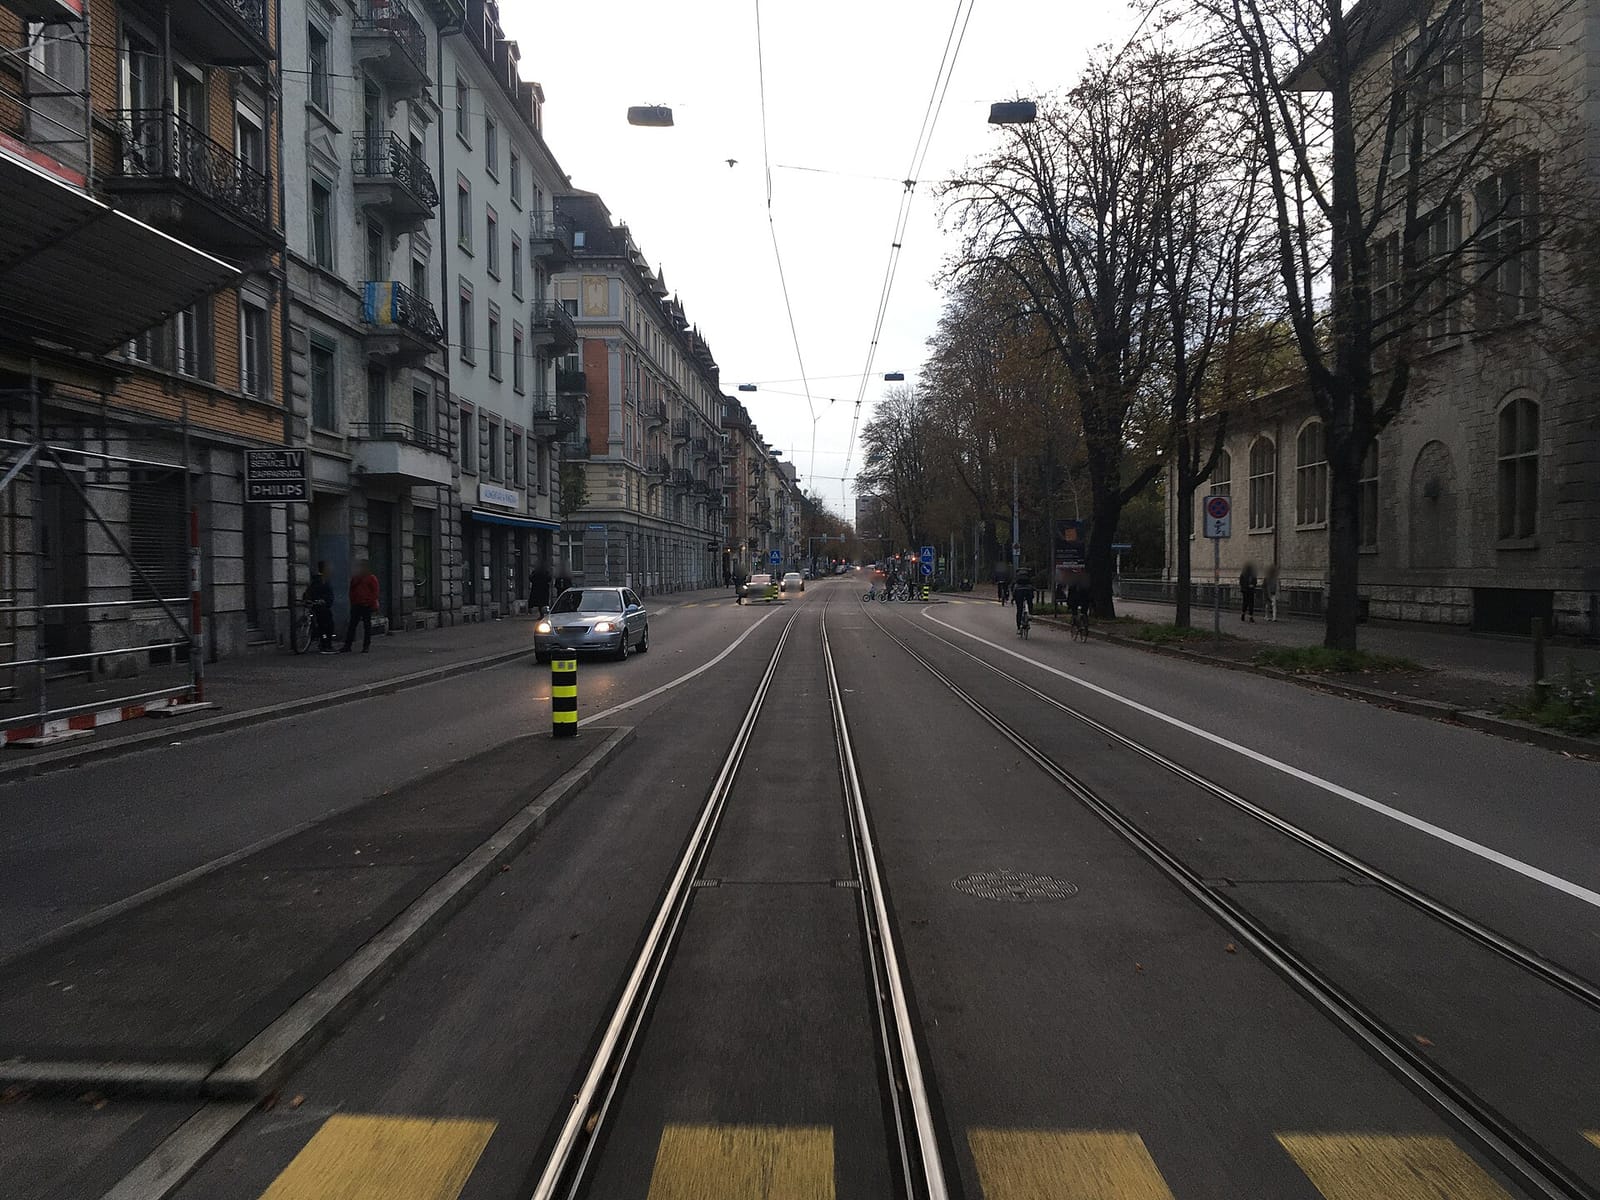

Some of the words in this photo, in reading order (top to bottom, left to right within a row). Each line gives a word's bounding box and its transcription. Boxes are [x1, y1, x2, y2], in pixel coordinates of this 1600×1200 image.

[250, 459, 286, 467] SERVICE
[283, 452, 301, 467] TV
[252, 484, 303, 495] PHILIPS
